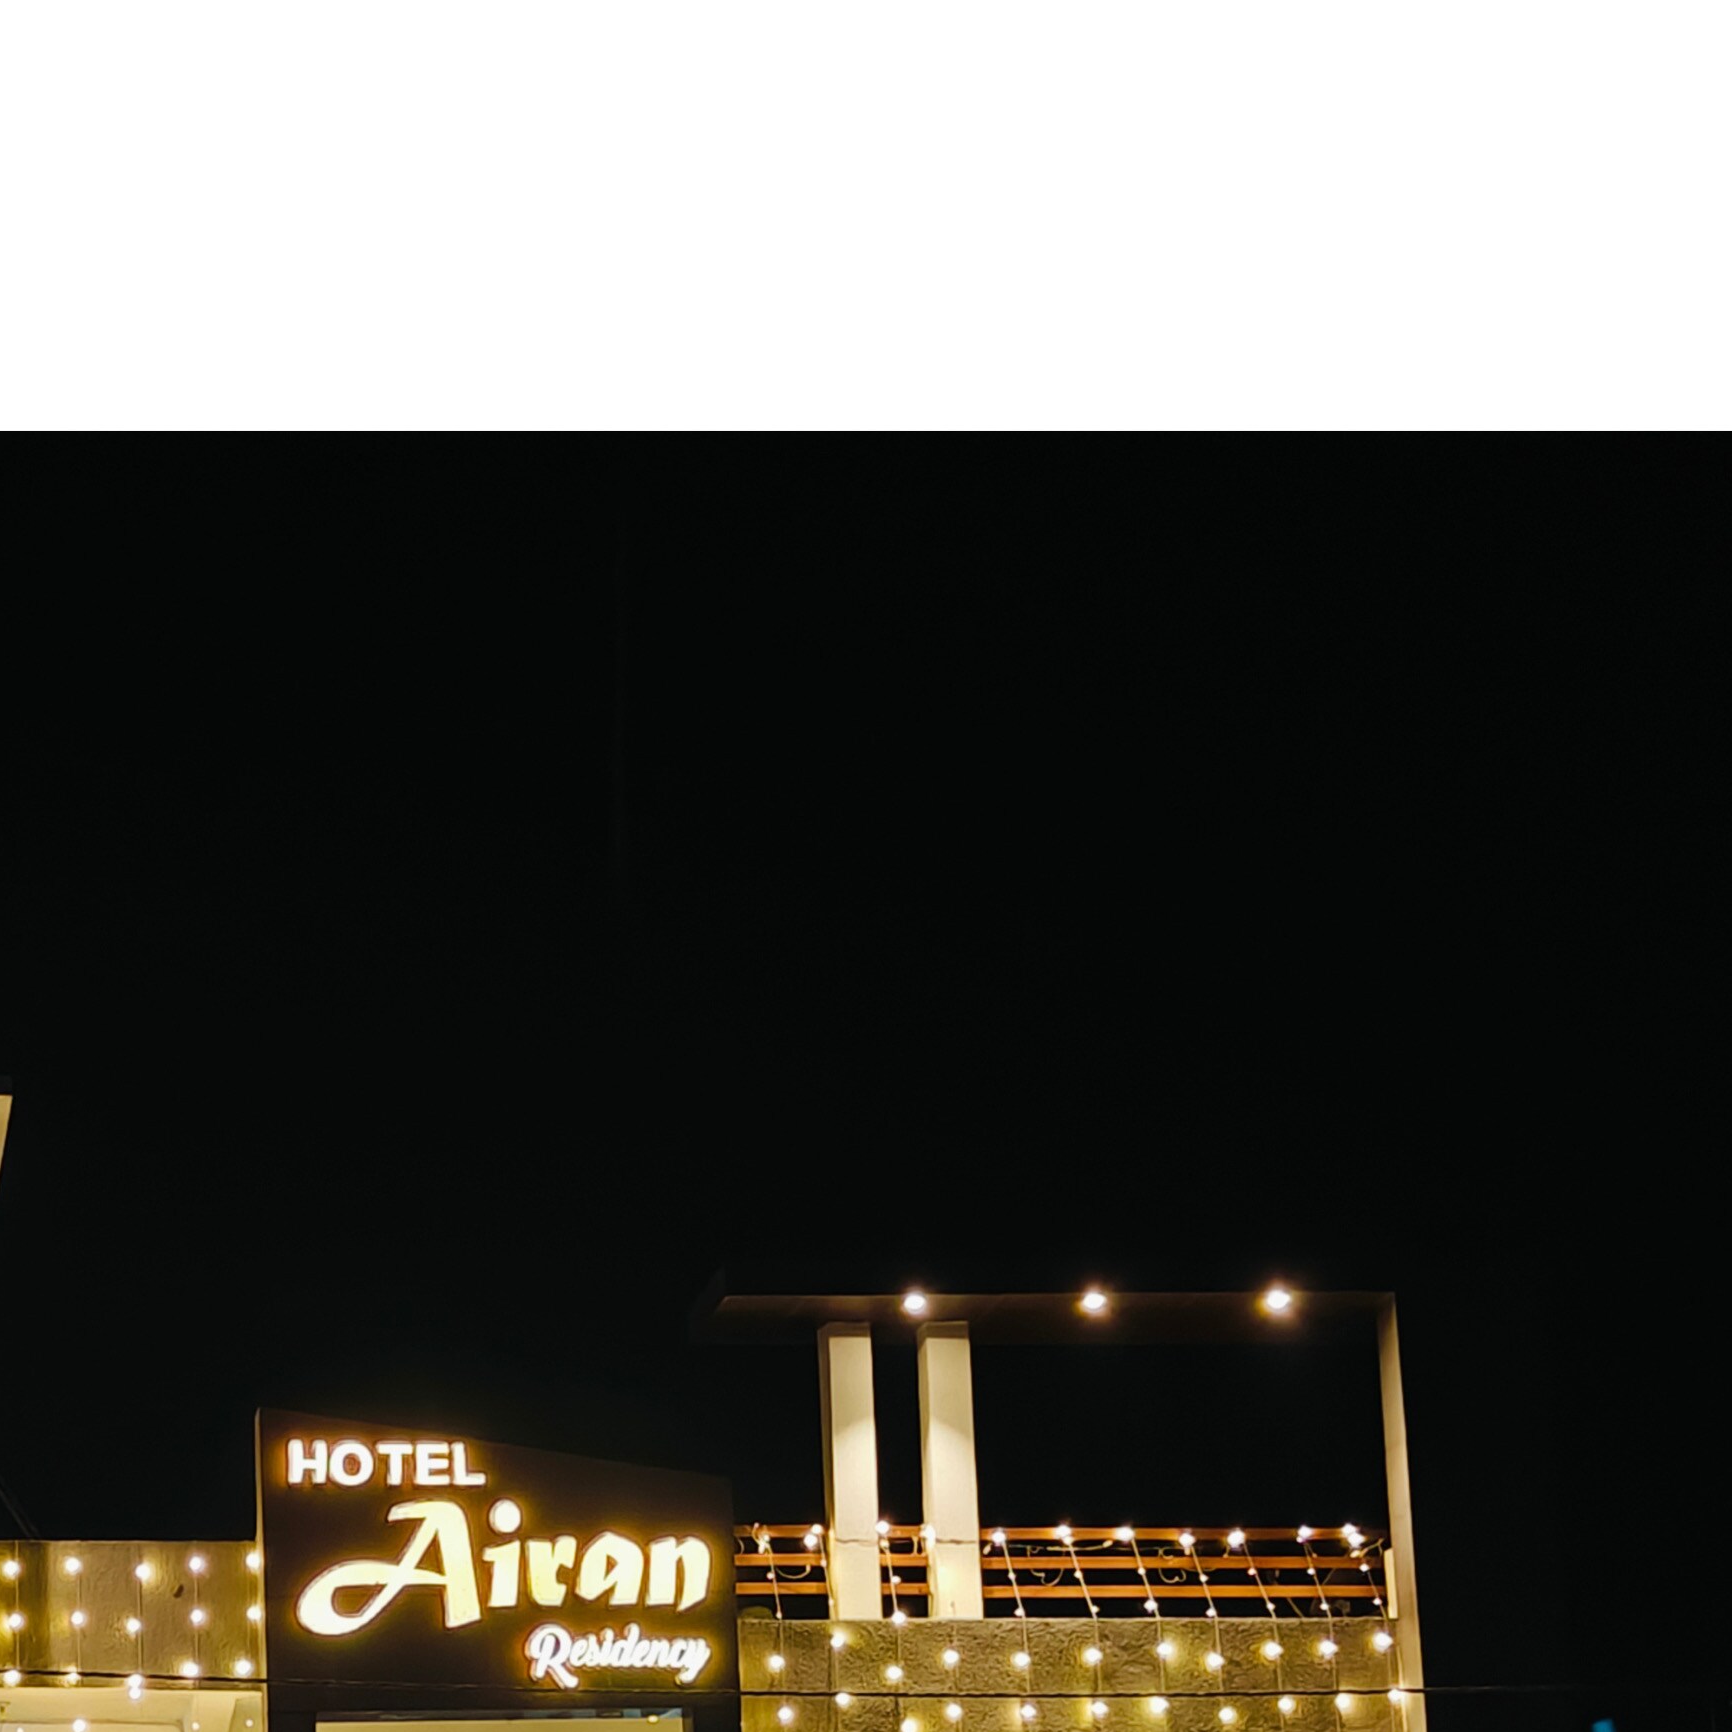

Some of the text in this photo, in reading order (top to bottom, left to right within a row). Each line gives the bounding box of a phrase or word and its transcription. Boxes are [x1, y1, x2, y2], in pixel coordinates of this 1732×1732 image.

[287, 1438, 486, 1486] HOTEL
[296, 1499, 711, 1636] Airan
[525, 1622, 711, 1688] Residency
